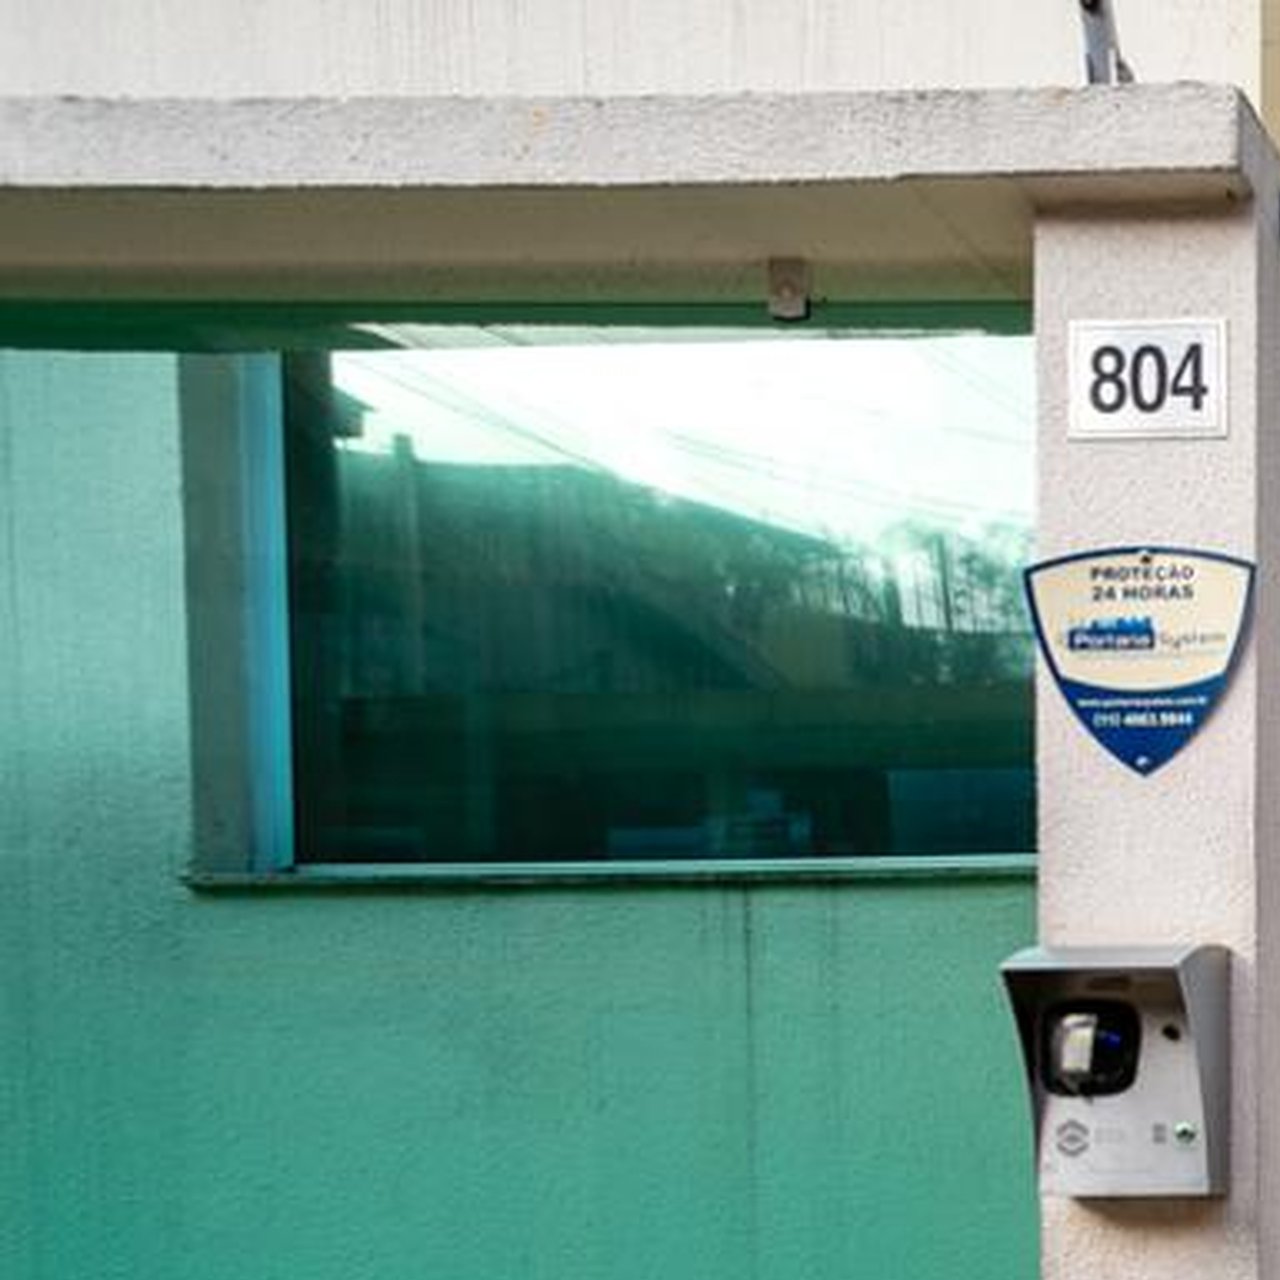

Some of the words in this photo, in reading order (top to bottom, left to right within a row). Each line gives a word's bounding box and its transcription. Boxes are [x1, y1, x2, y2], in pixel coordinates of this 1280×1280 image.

[1090, 342, 1208, 414] 804
[1091, 565, 1195, 582] PROTEÇÃO
[1092, 585, 1116, 601] 24
[1121, 585, 1194, 601] HORAS
